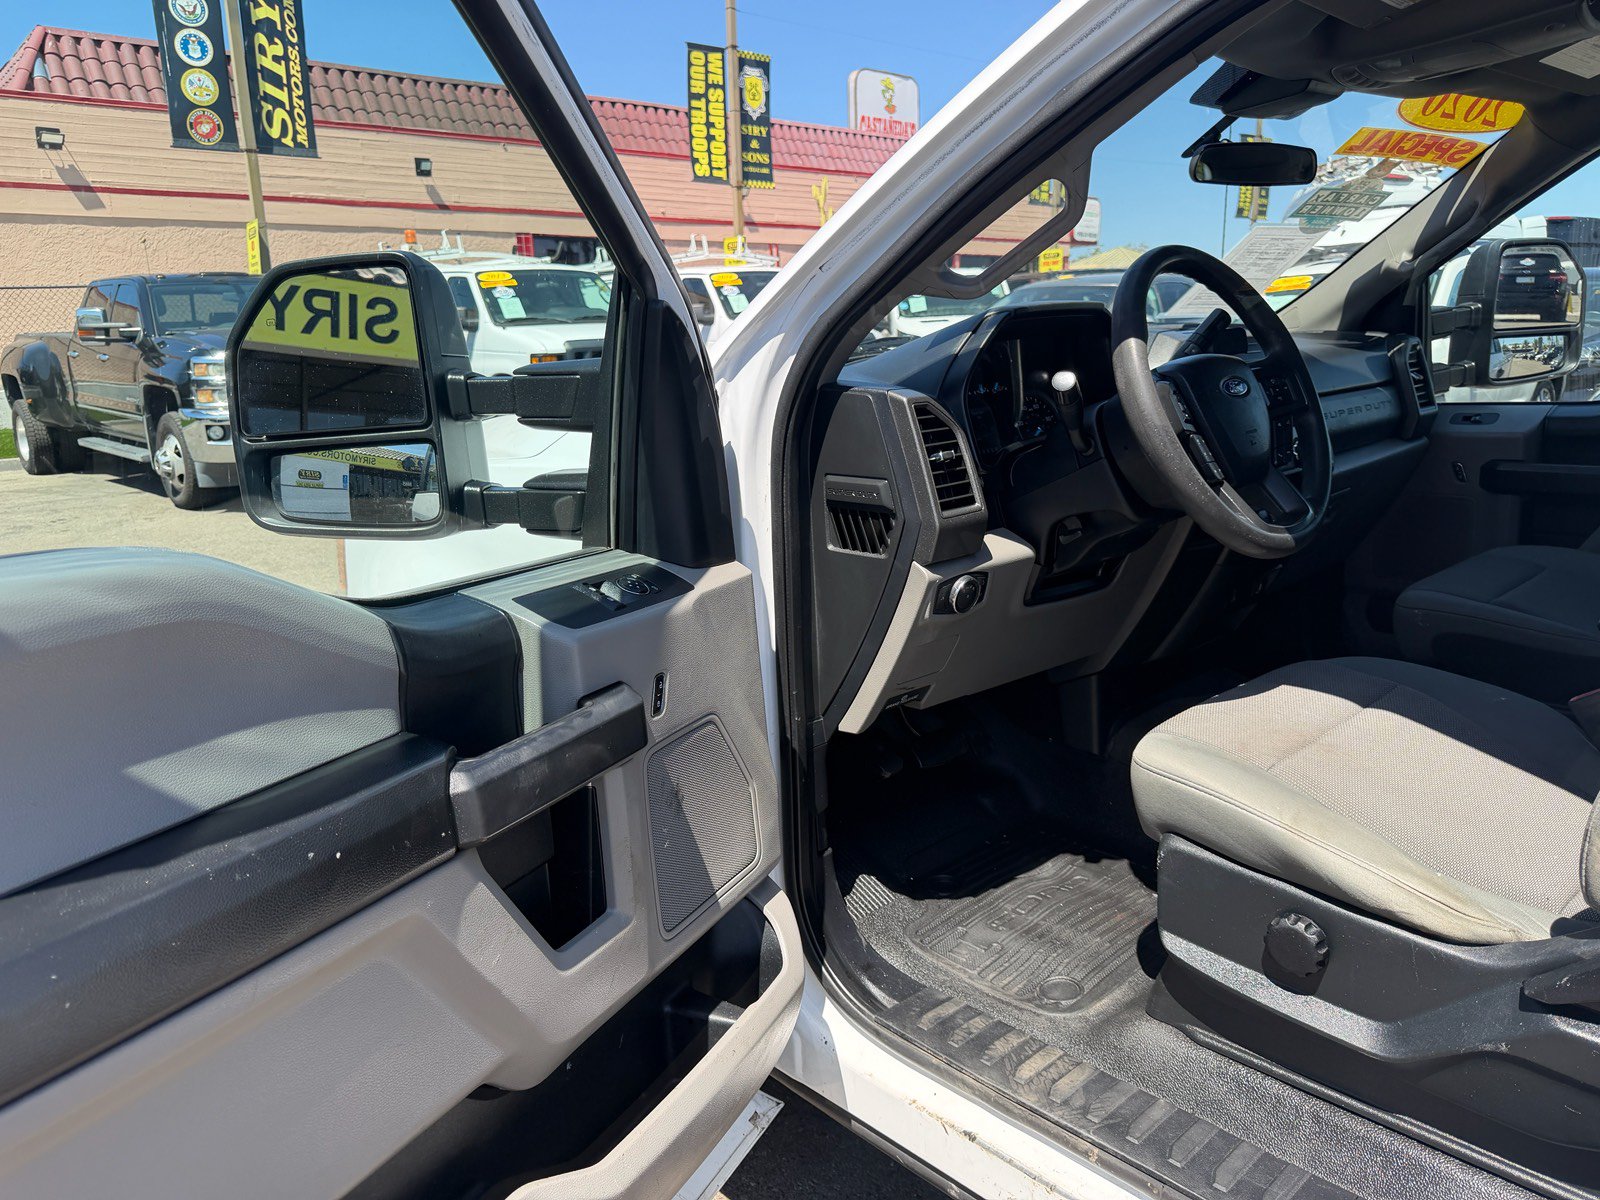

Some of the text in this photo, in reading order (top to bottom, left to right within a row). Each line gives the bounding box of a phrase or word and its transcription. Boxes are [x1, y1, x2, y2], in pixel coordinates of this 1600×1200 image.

[249, 0, 295, 148] SIRY
[689, 50, 711, 178] OUR TROOPS
[707, 51, 728, 181] WE SUPPORT
[741, 124, 769, 138] SIRY
[749, 139, 760, 149] &
[741, 151, 771, 166] SONS
[1323, 399, 1392, 420] SUPER DUTY
